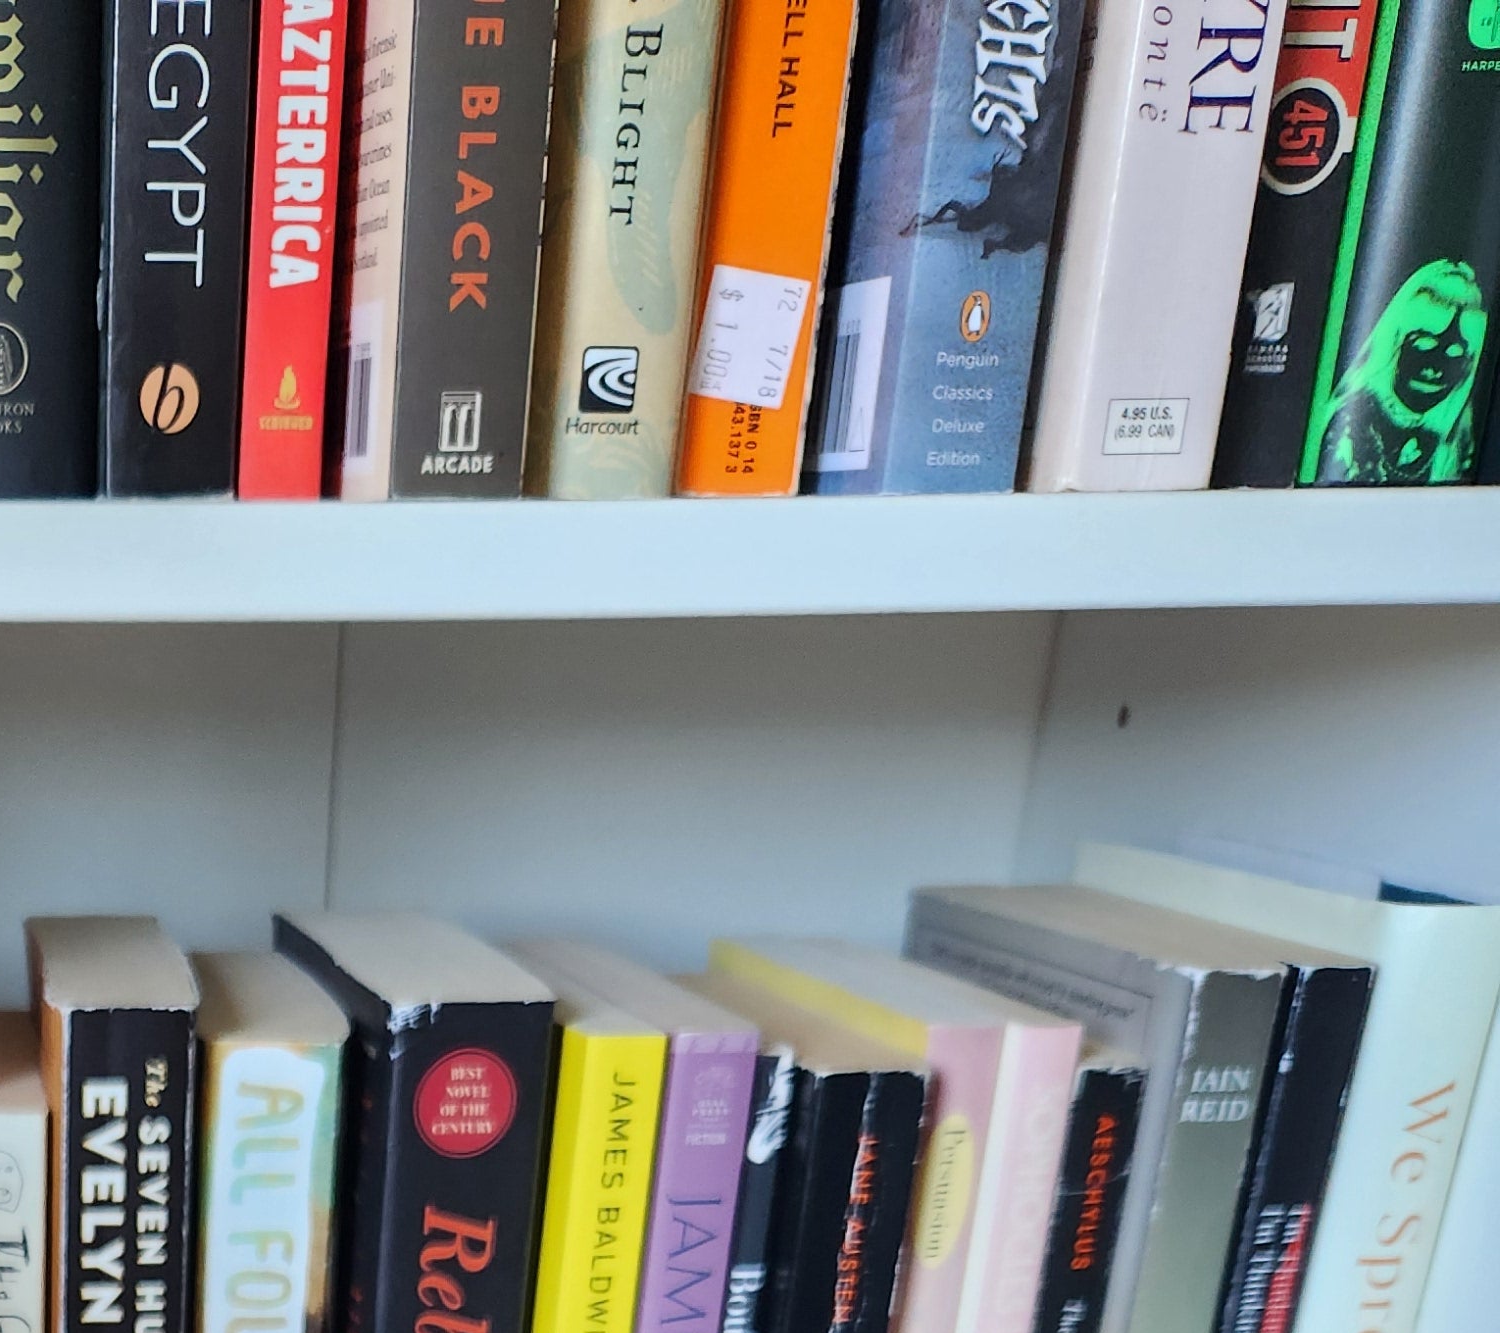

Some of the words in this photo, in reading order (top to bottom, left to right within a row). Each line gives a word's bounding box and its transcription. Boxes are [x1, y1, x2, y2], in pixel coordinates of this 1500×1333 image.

[1178, 0, 1270, 135] RE
[772, 57, 801, 139] HALL
[609, 24, 664, 226] BLIGHT
[1275, 100, 1328, 167] 451
[145, 0, 211, 287] EGYPT
[449, 86, 500, 312] BLACK
[778, 286, 803, 312] 72
[758, 345, 788, 398] 7/18
[936, 351, 999, 369] Penguin
[932, 385, 993, 401] Classics
[565, 417, 639, 436] Harcourt
[747, 404, 763, 434] SBN
[932, 419, 985, 434] Deluxe
[1121, 407, 1146, 420] 4.95
[1147, 407, 1172, 420] U.S.
[1114, 424, 1142, 439] (6.99
[1148, 424, 1175, 438] CAN)
[421, 454, 493, 475] ARCADE
[725, 465, 737, 473] 3
[743, 458, 755, 473] 14
[926, 452, 981, 467] Edition
[145, 1056, 169, 1108] The
[451, 1066, 485, 1081] BEST
[1191, 1068, 1254, 1092] IAIN
[446, 1085, 491, 1098] NOVEL
[439, 1104, 458, 1117] OF
[462, 1103, 489, 1117] THE
[1180, 1099, 1250, 1122] REID
[229, 1082, 301, 1204] ALL
[431, 1121, 493, 1135] CENTURY
[602, 1072, 637, 1190] JAMES
[1389, 1081, 1456, 1182] We
[851, 1134, 878, 1206] JANE
[80, 1077, 128, 1325] EVELYN
[136, 1115, 171, 1266] SEVEN
[923, 1129, 968, 1260] Persuasion
[1070, 1113, 1118, 1272] AESCHYLUS
[833, 1219, 864, 1323] AUSTEN
